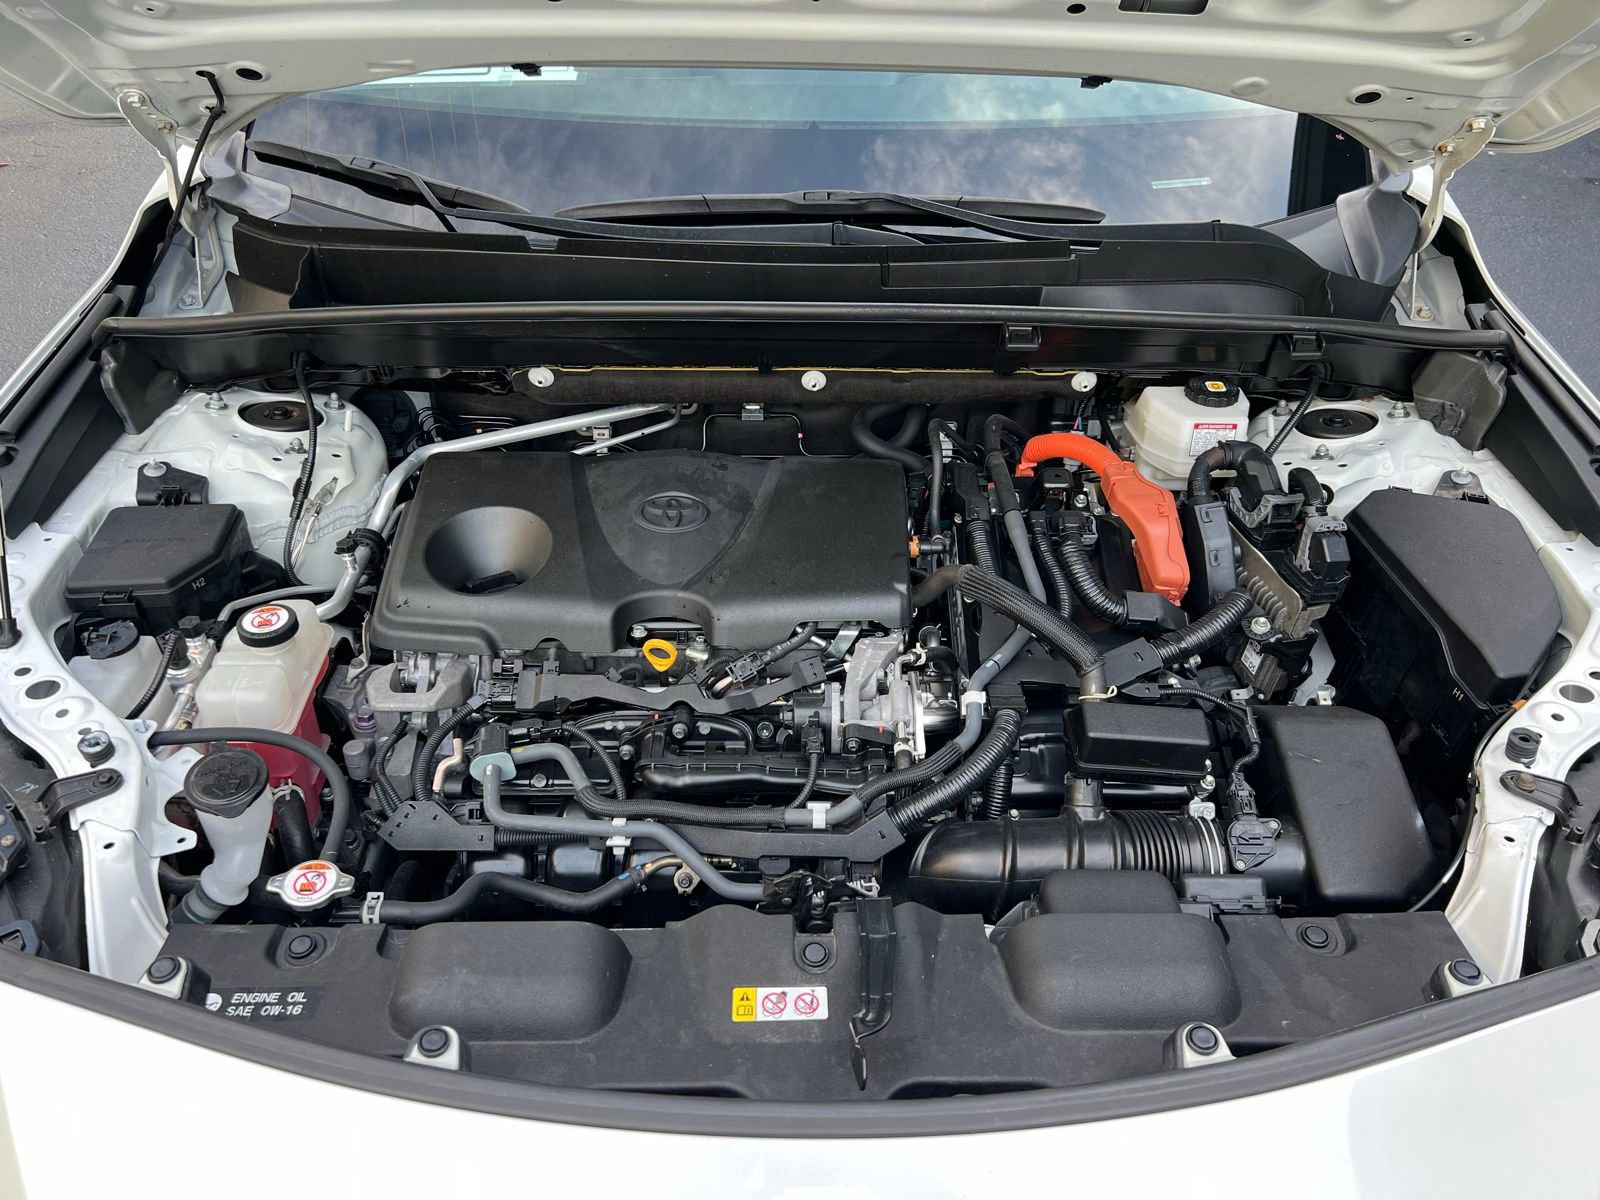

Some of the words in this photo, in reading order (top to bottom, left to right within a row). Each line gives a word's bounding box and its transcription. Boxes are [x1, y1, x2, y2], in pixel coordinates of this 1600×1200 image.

[192, 577, 206, 590] H2
[1452, 687, 1464, 701] H1
[231, 992, 281, 1004] ENGINE
[286, 991, 308, 1003] OIL
[225, 1005, 255, 1017] SAE
[260, 1004, 303, 1016] 0W-16
